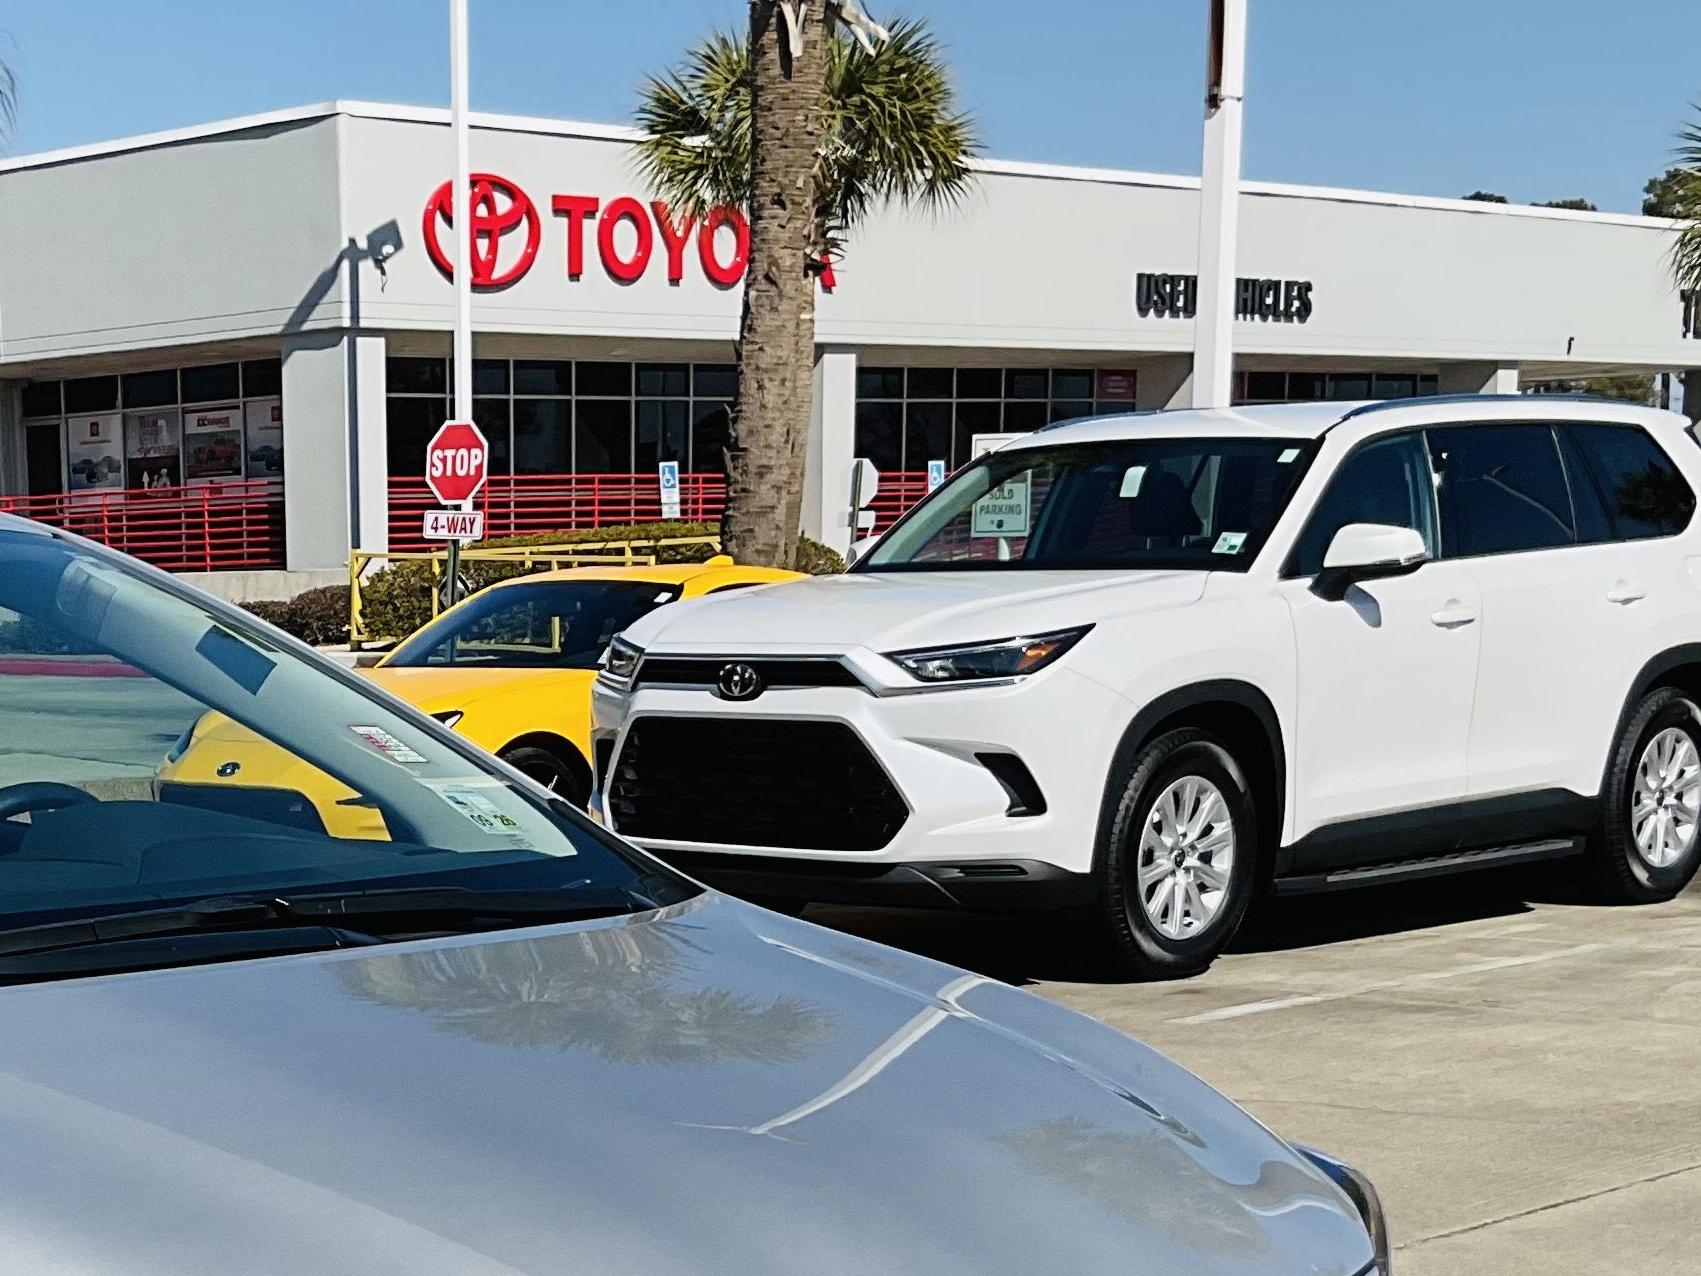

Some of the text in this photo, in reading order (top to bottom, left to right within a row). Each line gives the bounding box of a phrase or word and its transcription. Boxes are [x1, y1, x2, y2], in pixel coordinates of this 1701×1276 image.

[551, 194, 836, 287] TOYO
[1235, 278, 1312, 323] HICLES
[431, 448, 482, 477] STOP
[979, 504, 1022, 516] PARKING
[430, 516, 476, 534] 4-WAY
